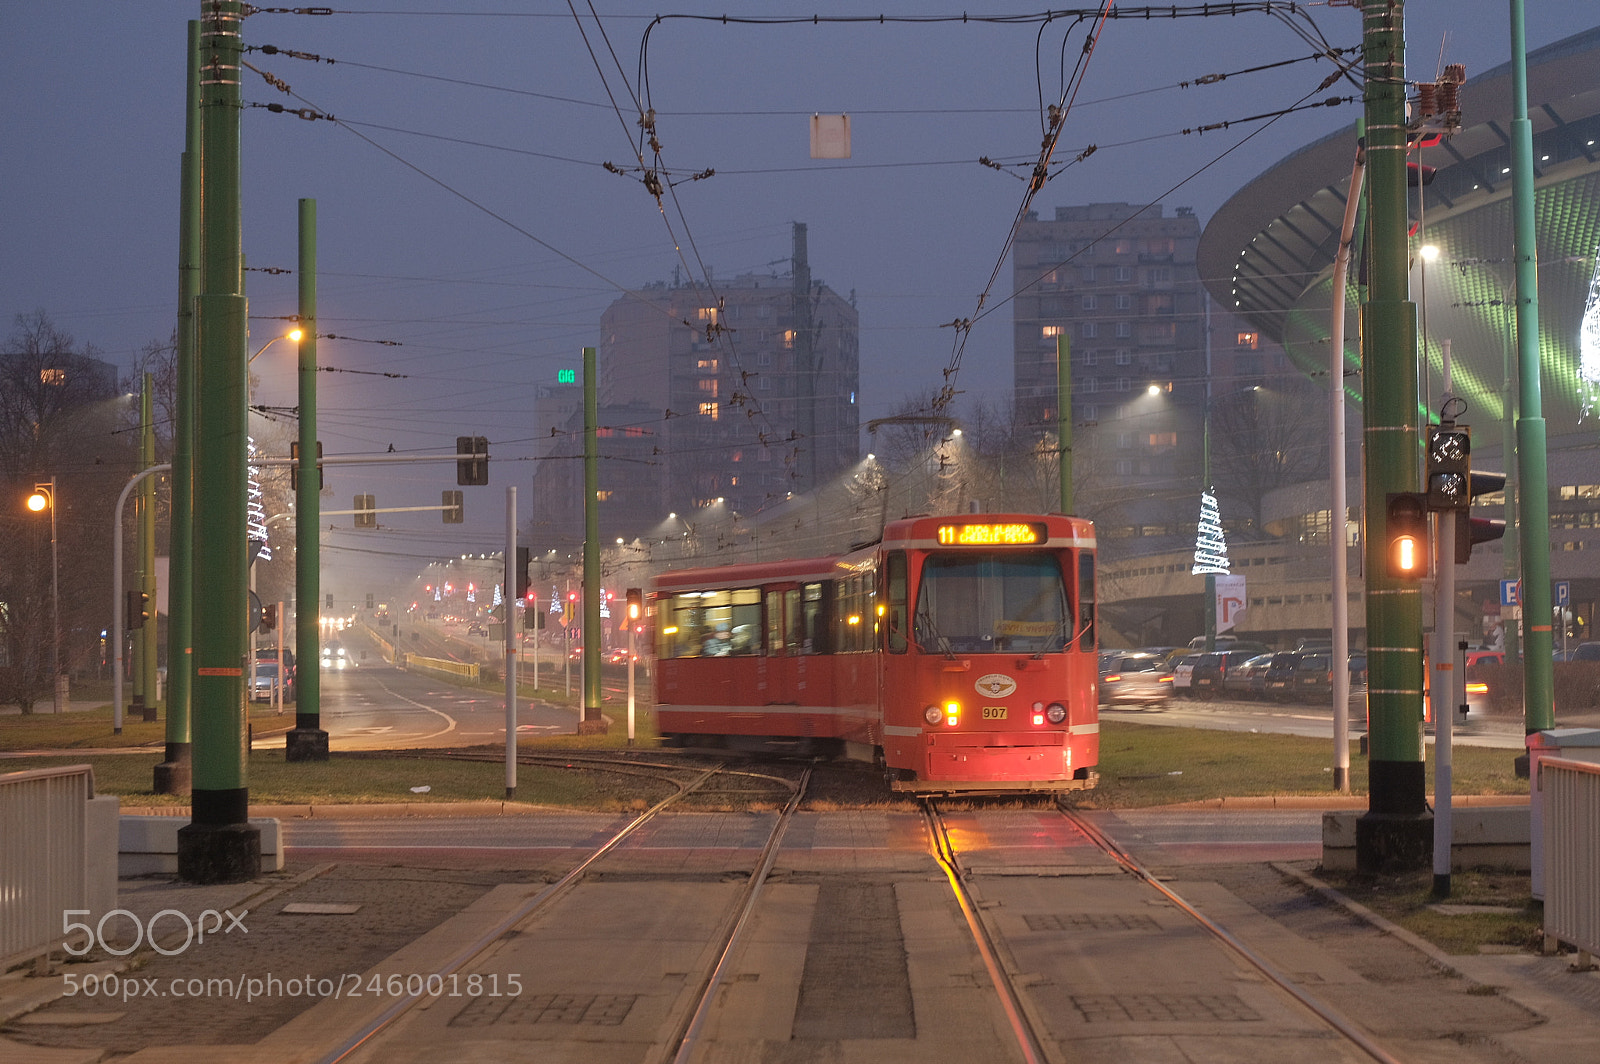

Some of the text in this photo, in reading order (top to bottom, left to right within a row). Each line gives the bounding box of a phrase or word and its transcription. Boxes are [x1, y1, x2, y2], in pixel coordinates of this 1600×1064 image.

[558, 369, 575, 384] GIG
[939, 526, 954, 543] 11
[1559, 585, 1567, 604] P
[983, 708, 1006, 718] 907
